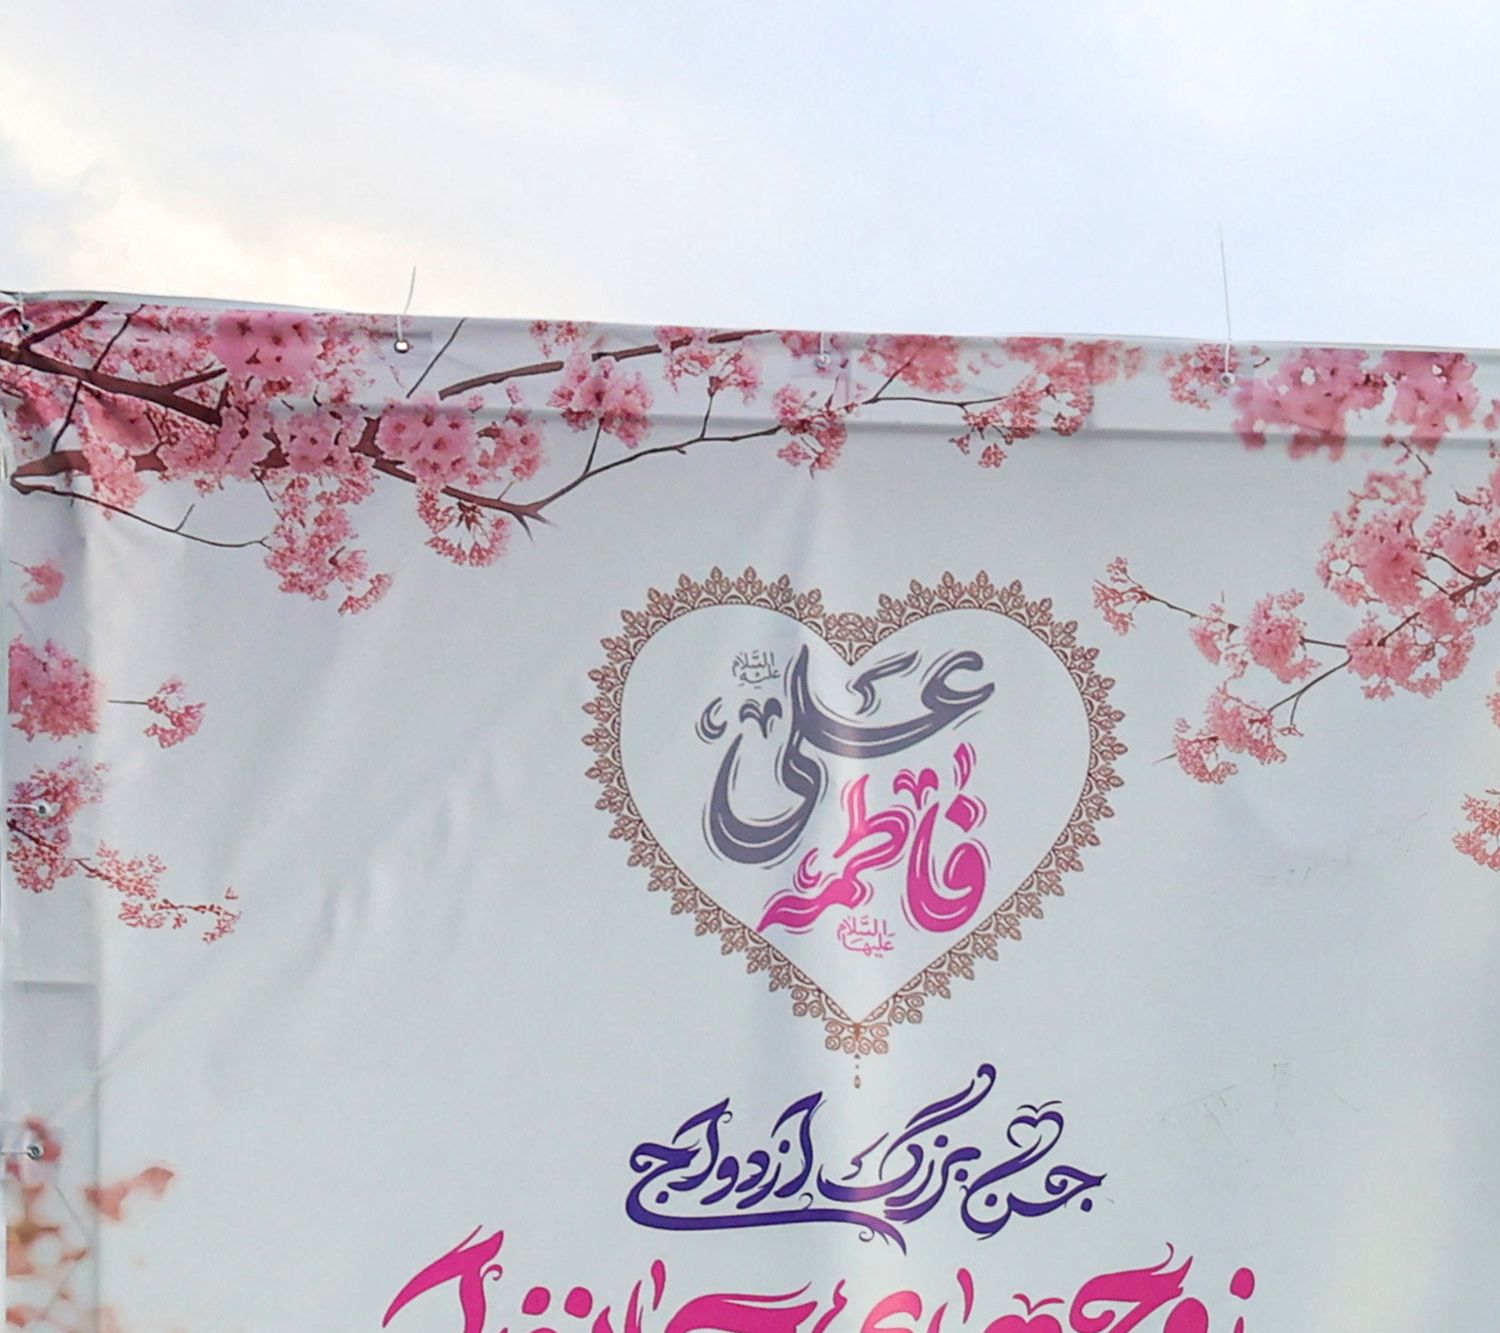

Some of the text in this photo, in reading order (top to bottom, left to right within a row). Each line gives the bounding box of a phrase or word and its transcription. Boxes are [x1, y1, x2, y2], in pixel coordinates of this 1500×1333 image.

[697, 644, 995, 867] علی
[756, 743, 990, 934] فاطمه
[626, 1063, 1108, 1256] جشن بزرگ ازدواج
